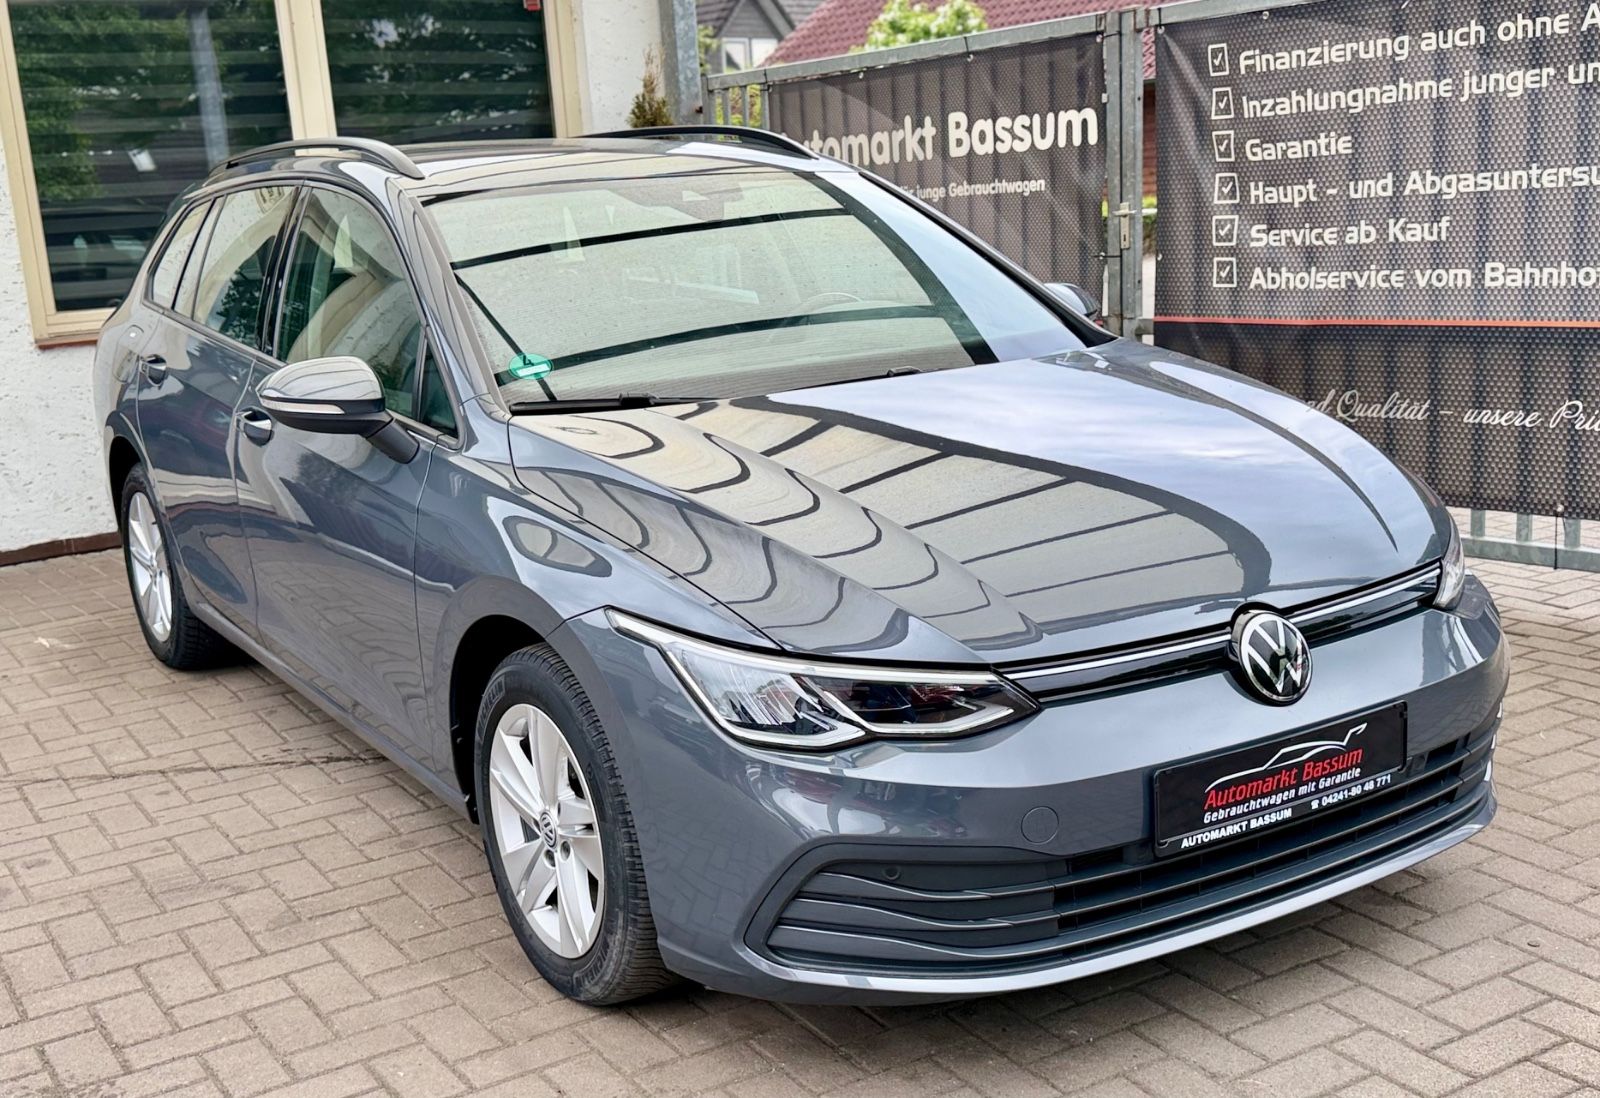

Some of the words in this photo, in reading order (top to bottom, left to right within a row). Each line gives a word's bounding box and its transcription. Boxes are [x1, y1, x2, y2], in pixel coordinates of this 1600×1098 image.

[1239, 34, 1409, 75] Finanzierung
[1420, 20, 1485, 51] auch
[1497, 13, 1570, 41] ohne
[1242, 76, 1453, 118] Inzahlungnahme
[1461, 66, 1555, 100] junger
[781, 115, 936, 166] tomarkt
[948, 107, 1098, 158] Bassum
[1245, 131, 1353, 162] Garantie
[949, 177, 1045, 198] Gebrauchtwagen
[1249, 179, 1317, 208] Haupt
[1349, 173, 1394, 200] und
[1249, 221, 1338, 248] Service
[1345, 218, 1377, 243] ab
[1388, 215, 1451, 244] Kauf
[1249, 264, 1405, 290] Abholservice
[1415, 267, 1472, 289] vom
[1484, 260, 1600, 288] Bahnho
[1336, 389, 1430, 422] Qualität
[1462, 409, 1543, 428] unsere
[1203, 767, 1298, 810] Automarkt
[1302, 748, 1363, 782] Bassum
[1203, 788, 1295, 824] Gebrauchtwagen
[1299, 781, 1316, 796] mit
[1318, 767, 1361, 790] Garantie
[1375, 773, 1391, 788] 771
[1181, 820, 1249, 849] AUTOMARKT
[1249, 807, 1292, 829] BASSUM
